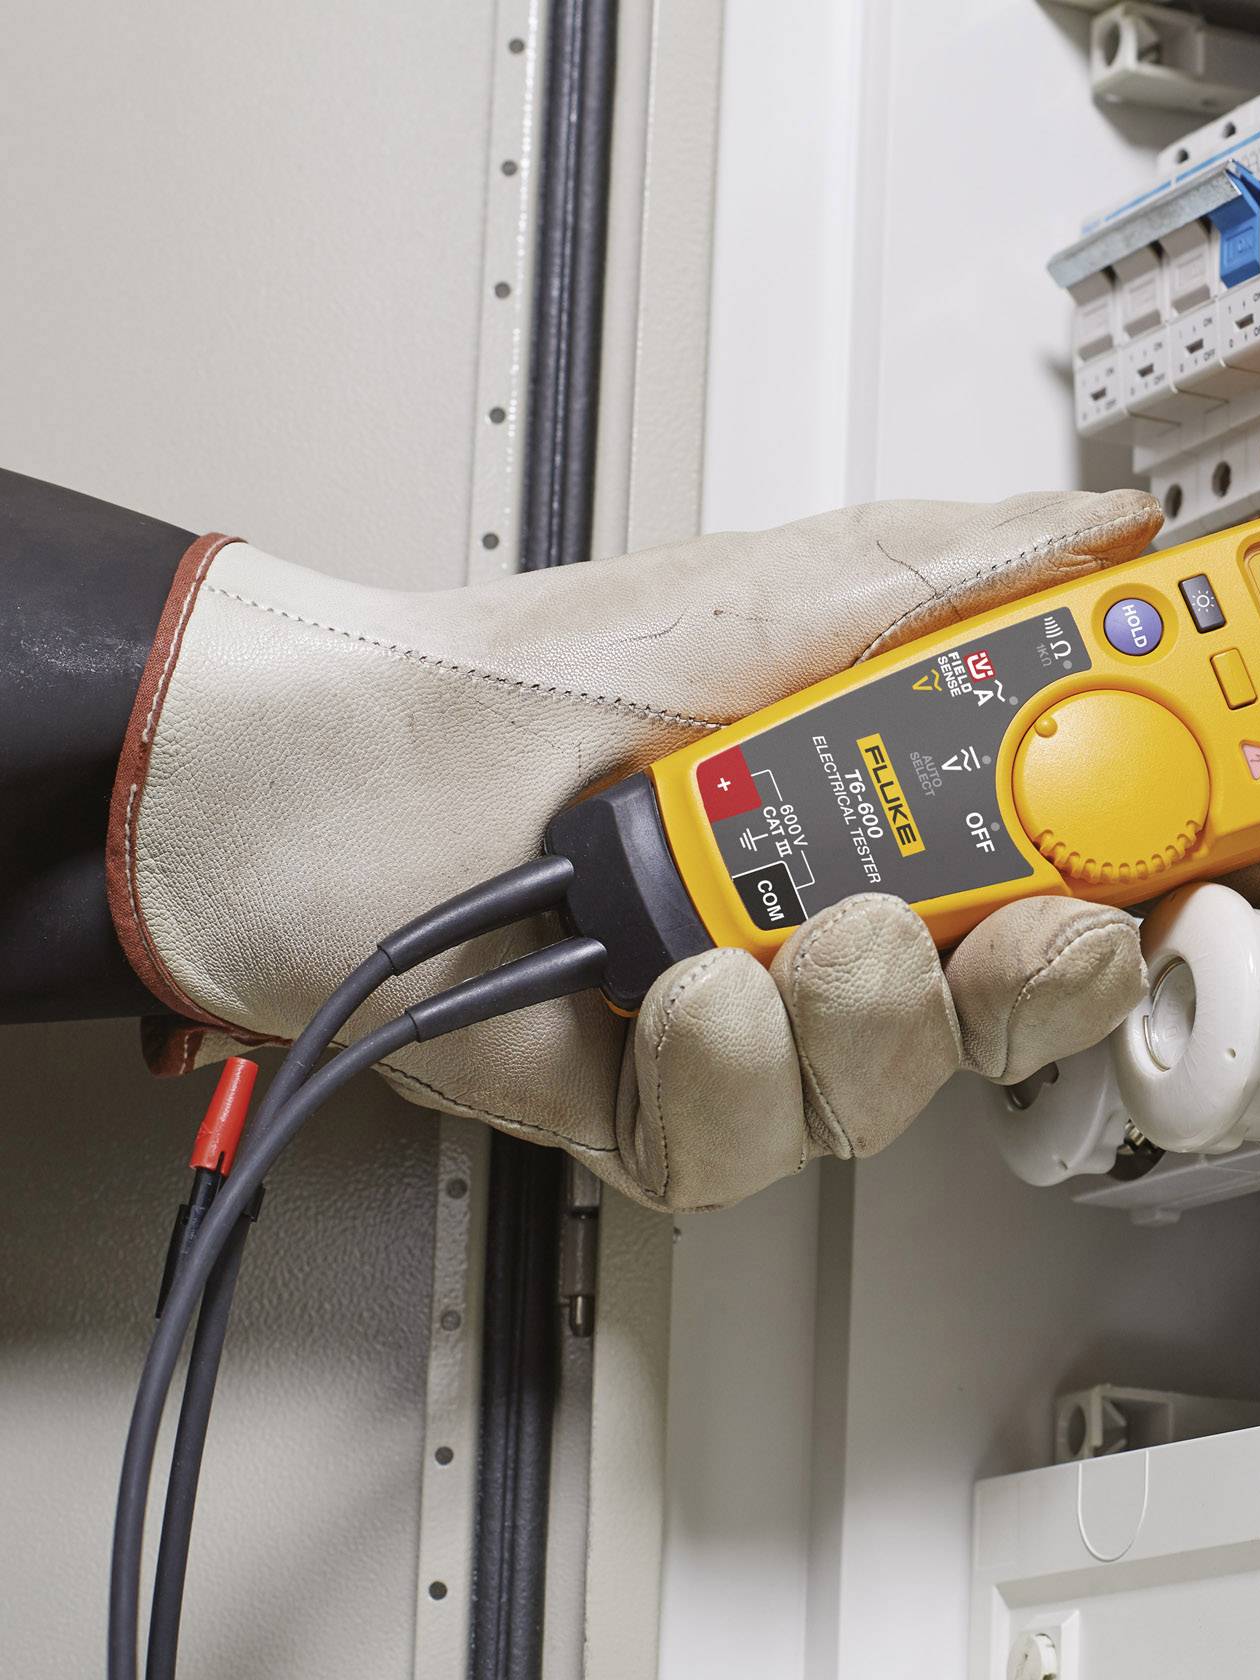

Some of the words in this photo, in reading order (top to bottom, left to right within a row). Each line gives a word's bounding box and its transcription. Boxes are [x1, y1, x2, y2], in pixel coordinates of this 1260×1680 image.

[1122, 604, 1148, 648] HOLD
[937, 656, 962, 697] SENSE
[947, 651, 973, 694] FIELD
[910, 752, 936, 797] SELECT
[922, 755, 943, 788] AUTO
[812, 735, 857, 825] ELECTRICAL
[850, 828, 881, 884] TESTER
[845, 768, 884, 839] T6-600
[864, 745, 917, 846] FLUKE
[763, 805, 785, 836] CAT
[780, 804, 808, 847] 600V
[965, 811, 995, 853] OFF
[757, 879, 785, 922] COM
